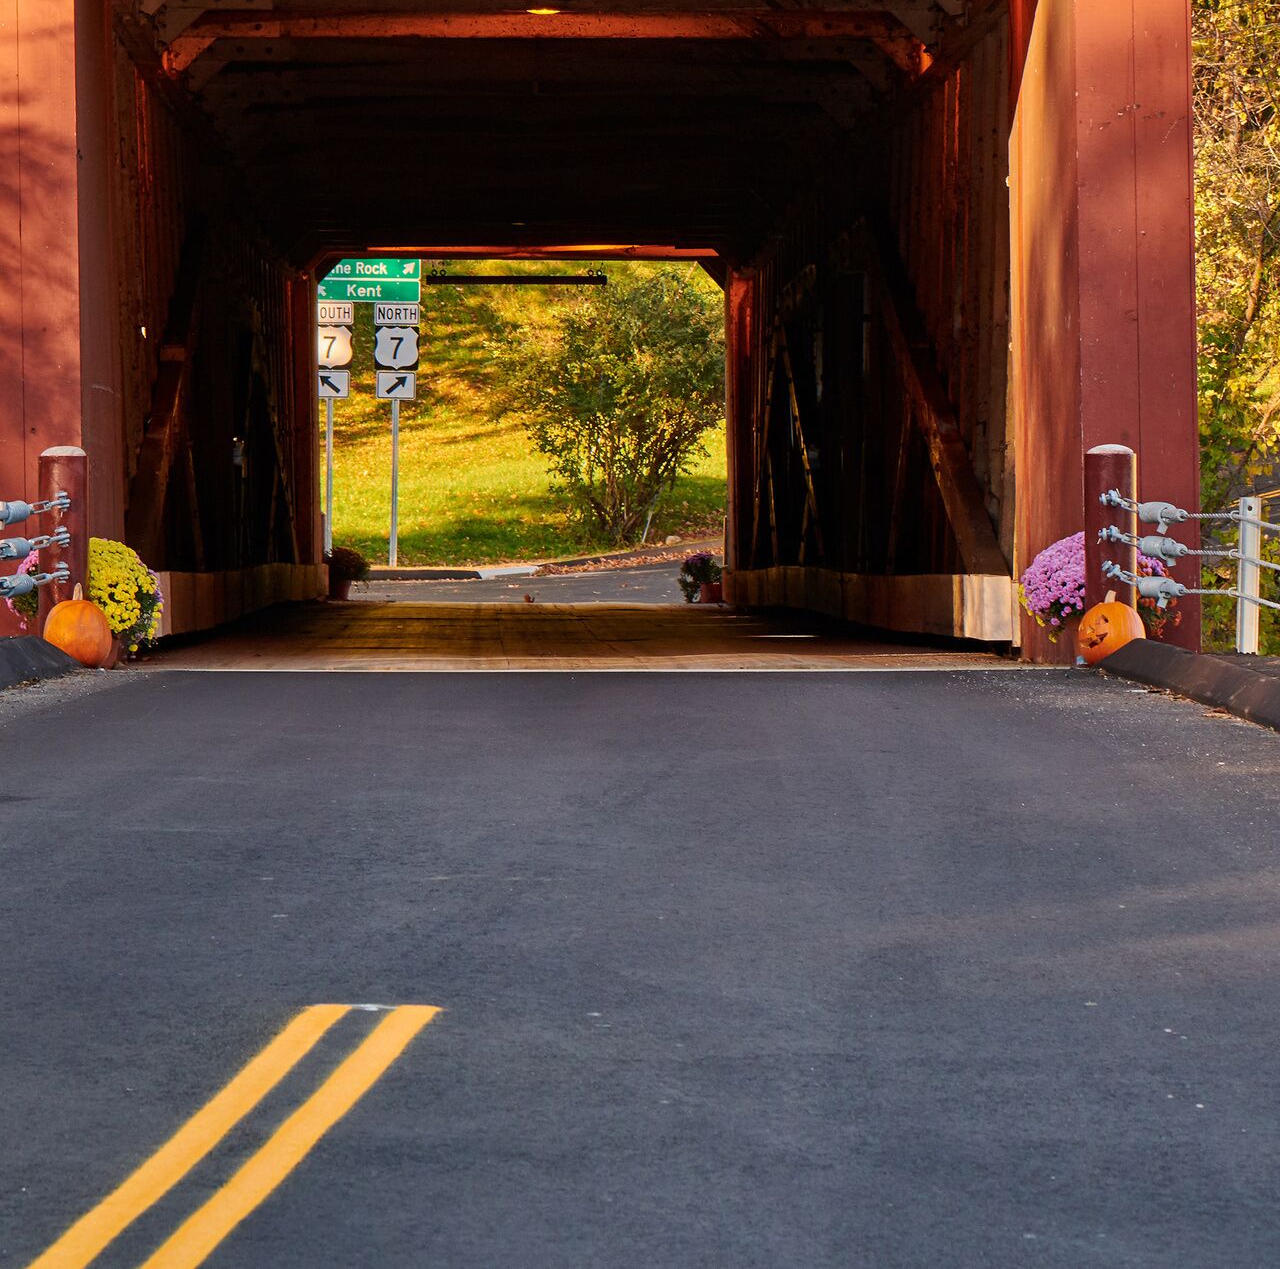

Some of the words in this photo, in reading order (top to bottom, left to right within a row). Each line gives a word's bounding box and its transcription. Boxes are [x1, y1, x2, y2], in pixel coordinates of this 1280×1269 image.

[356, 262, 388, 275] Rock
[347, 284, 382, 298] Kent
[320, 307, 350, 319] OUTH
[378, 307, 417, 320] NORTH
[323, 336, 336, 359] 7
[390, 337, 404, 360] 7
